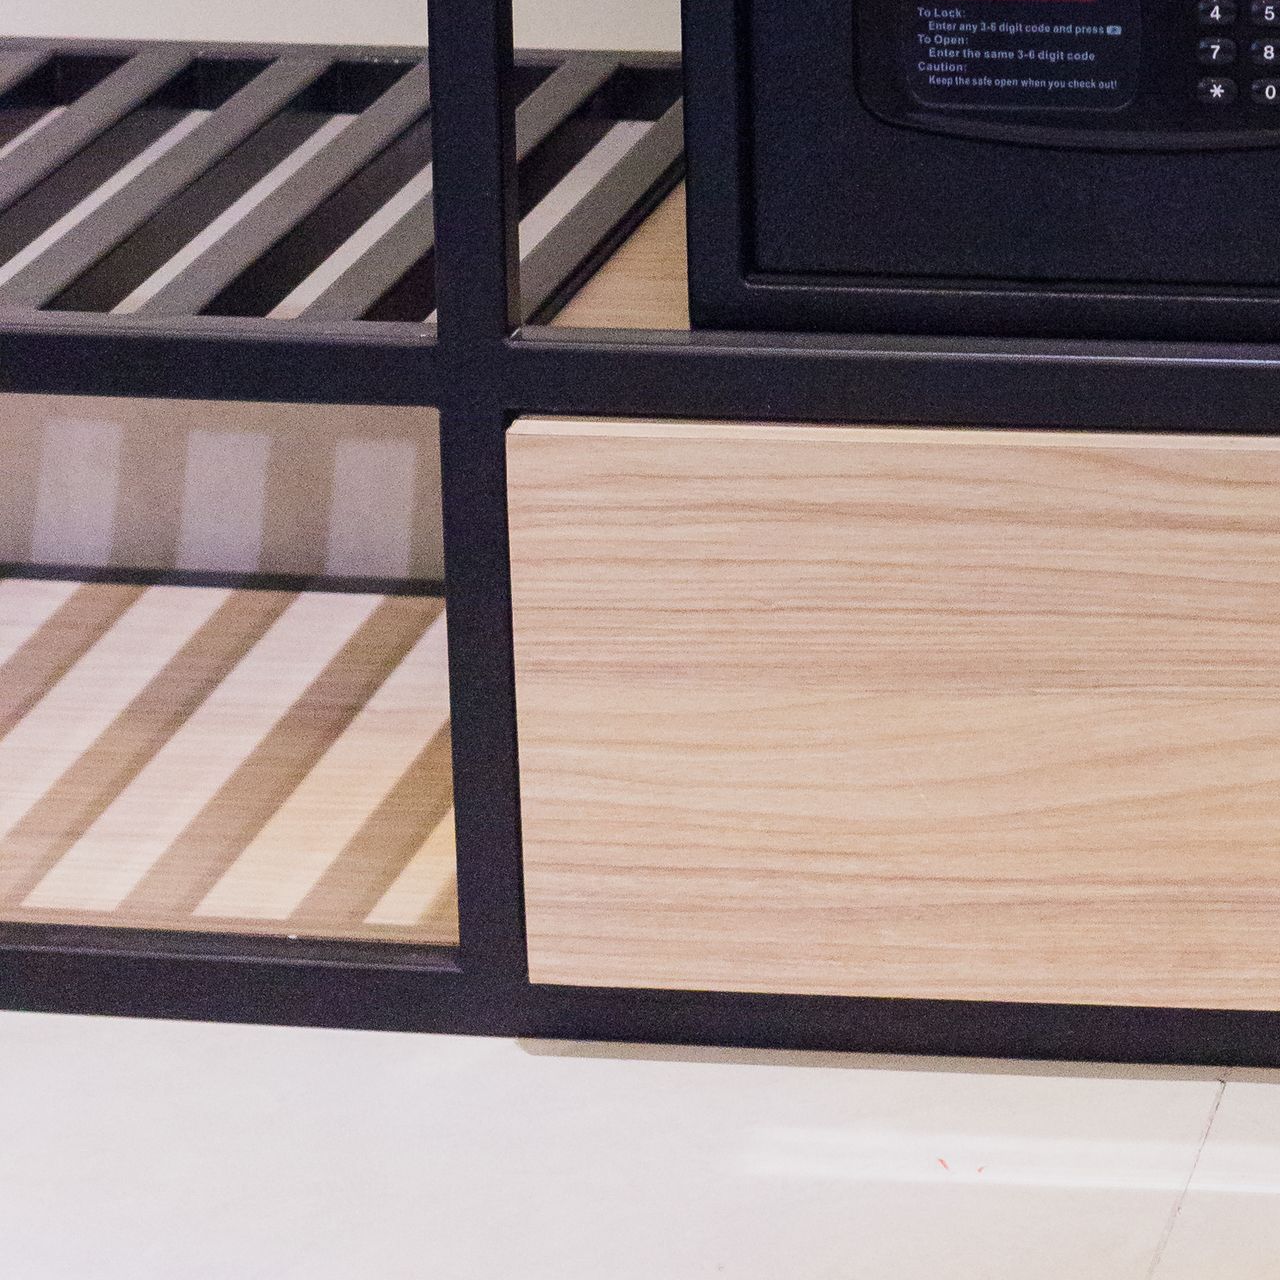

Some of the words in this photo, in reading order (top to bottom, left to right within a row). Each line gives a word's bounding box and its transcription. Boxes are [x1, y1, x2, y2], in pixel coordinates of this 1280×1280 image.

[917, 7, 931, 17] To
[934, 8, 966, 18] Lock:
[1210, 6, 1221, 21] 4
[1264, 6, 1275, 21] 5
[928, 21, 957, 31] Enter
[959, 22, 978, 34] any
[980, 22, 997, 32] 3-6
[998, 22, 1023, 35] digit
[1025, 23, 1051, 34] code
[1053, 24, 1073, 34] and
[1075, 26, 1104, 36] press
[917, 34, 932, 45] To
[934, 34, 969, 46] Open:
[928, 47, 960, 58] Enter
[962, 48, 981, 59] the
[984, 51, 1015, 59] same
[1037, 50, 1064, 63] digit
[1066, 51, 1095, 62] code
[1210, 45, 1220, 60] 7
[1263, 45, 1275, 60] 8
[917, 61, 967, 72] Caution:
[928, 74, 953, 87] Keep
[954, 76, 971, 86] the
[972, 76, 993, 87] safe
[994, 78, 1018, 89] open
[1020, 78, 1047, 87] when
[1048, 80, 1066, 91] you
[1068, 78, 1096, 88] check
[1265, 85, 1276, 100] 0
